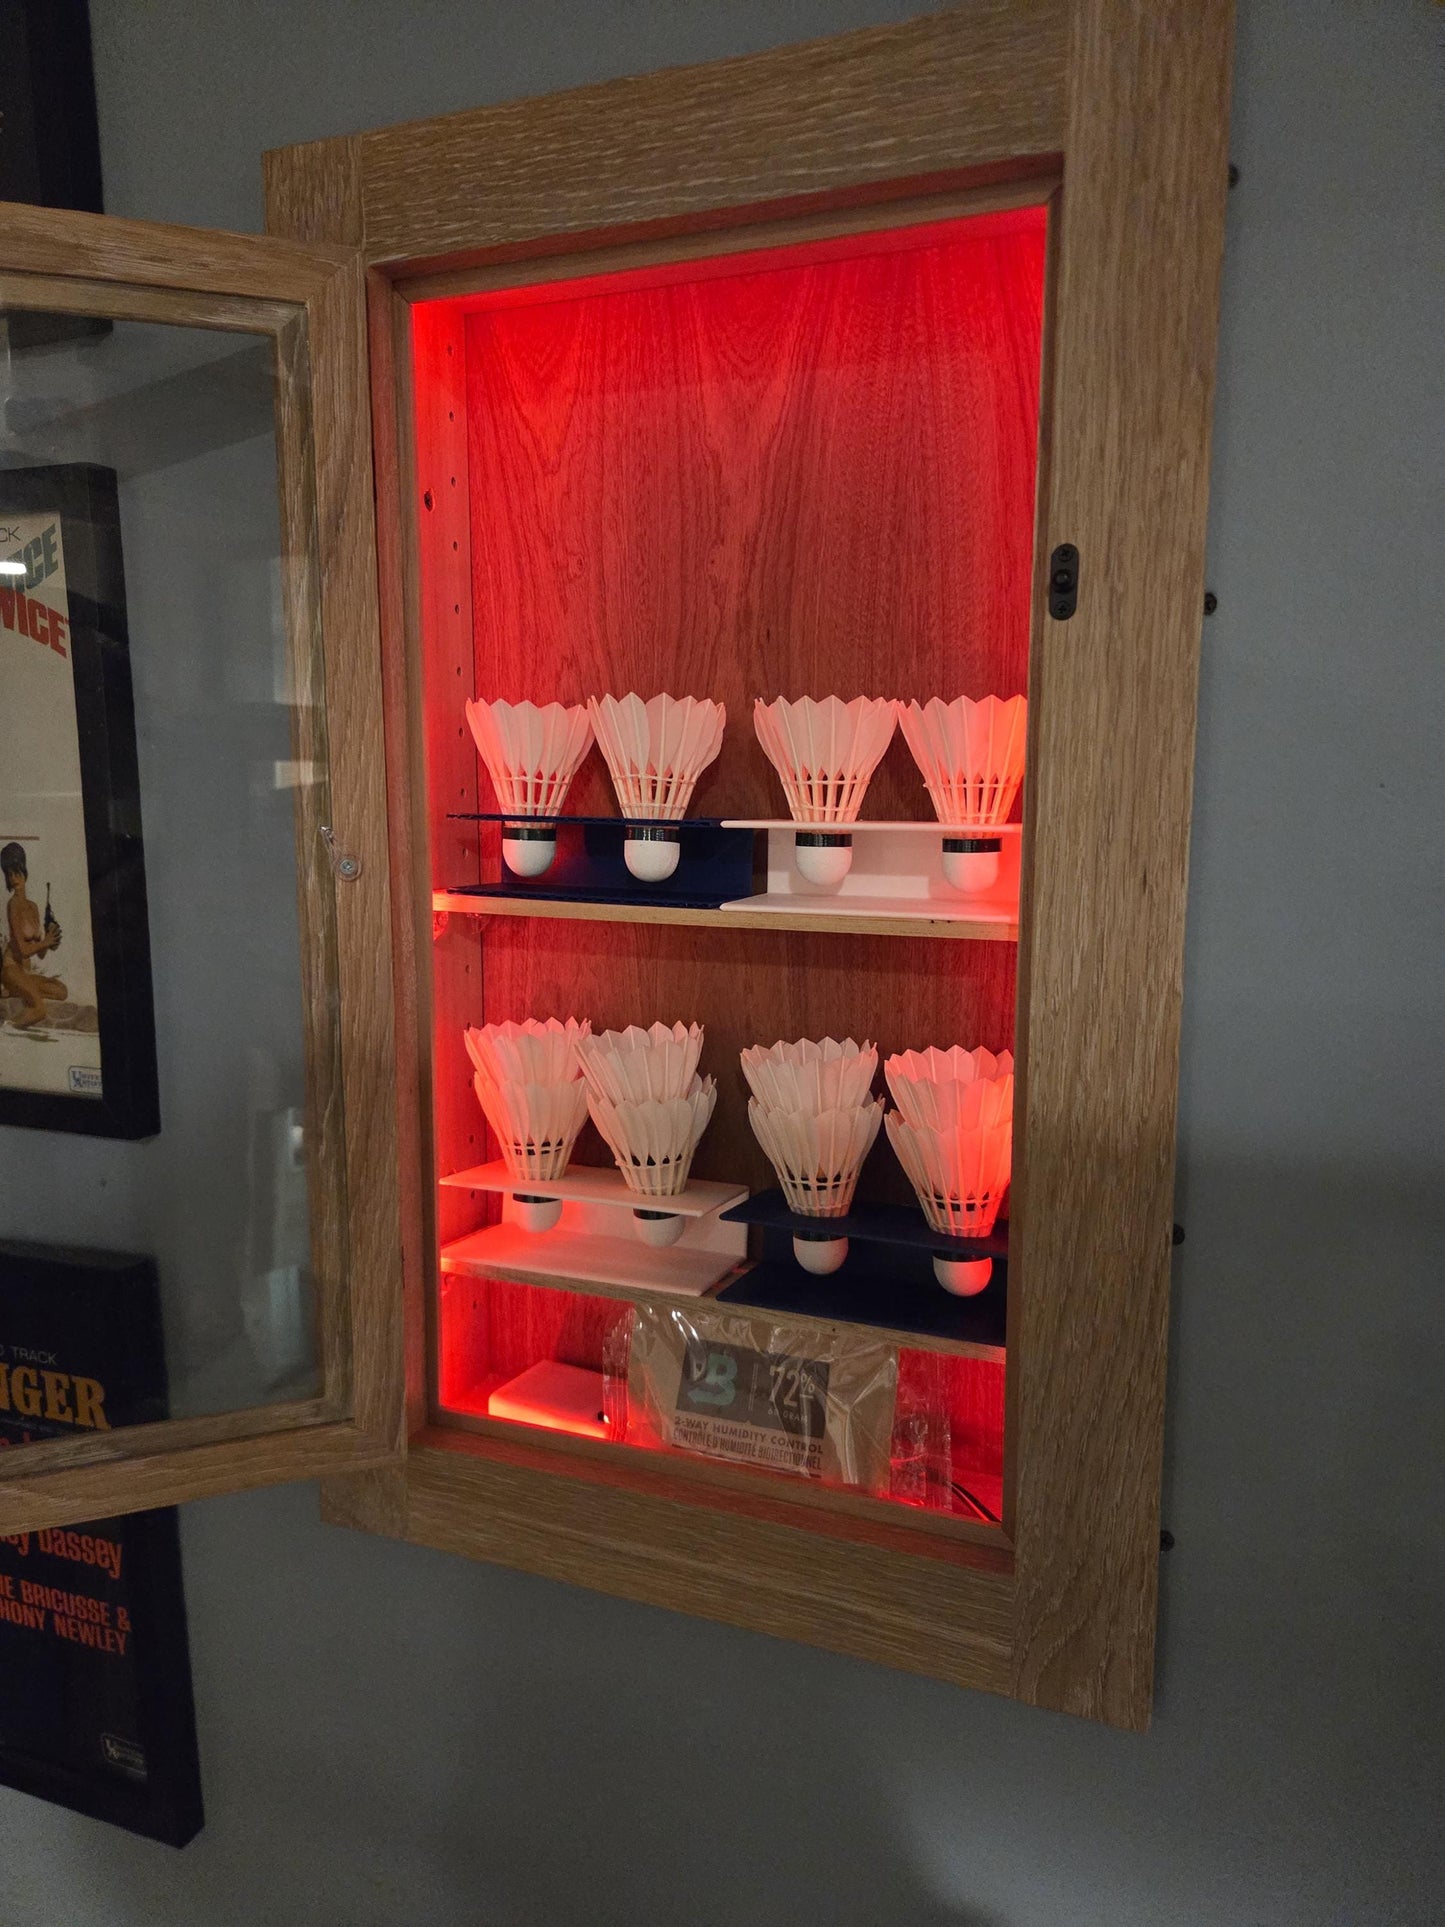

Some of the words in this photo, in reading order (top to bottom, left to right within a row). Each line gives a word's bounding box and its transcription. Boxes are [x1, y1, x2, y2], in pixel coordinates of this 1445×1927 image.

[10, 1345, 58, 1366] TRACK
[769, 1365, 815, 1407] 72%
[674, 1416, 709, 1430] 2-WAY
[713, 1423, 766, 1442] HUMIDITY
[771, 1436, 824, 1454] CONTROL
[20, 1579, 111, 1627] BRICUSSE
[54, 1613, 126, 1655] NEWLEY
